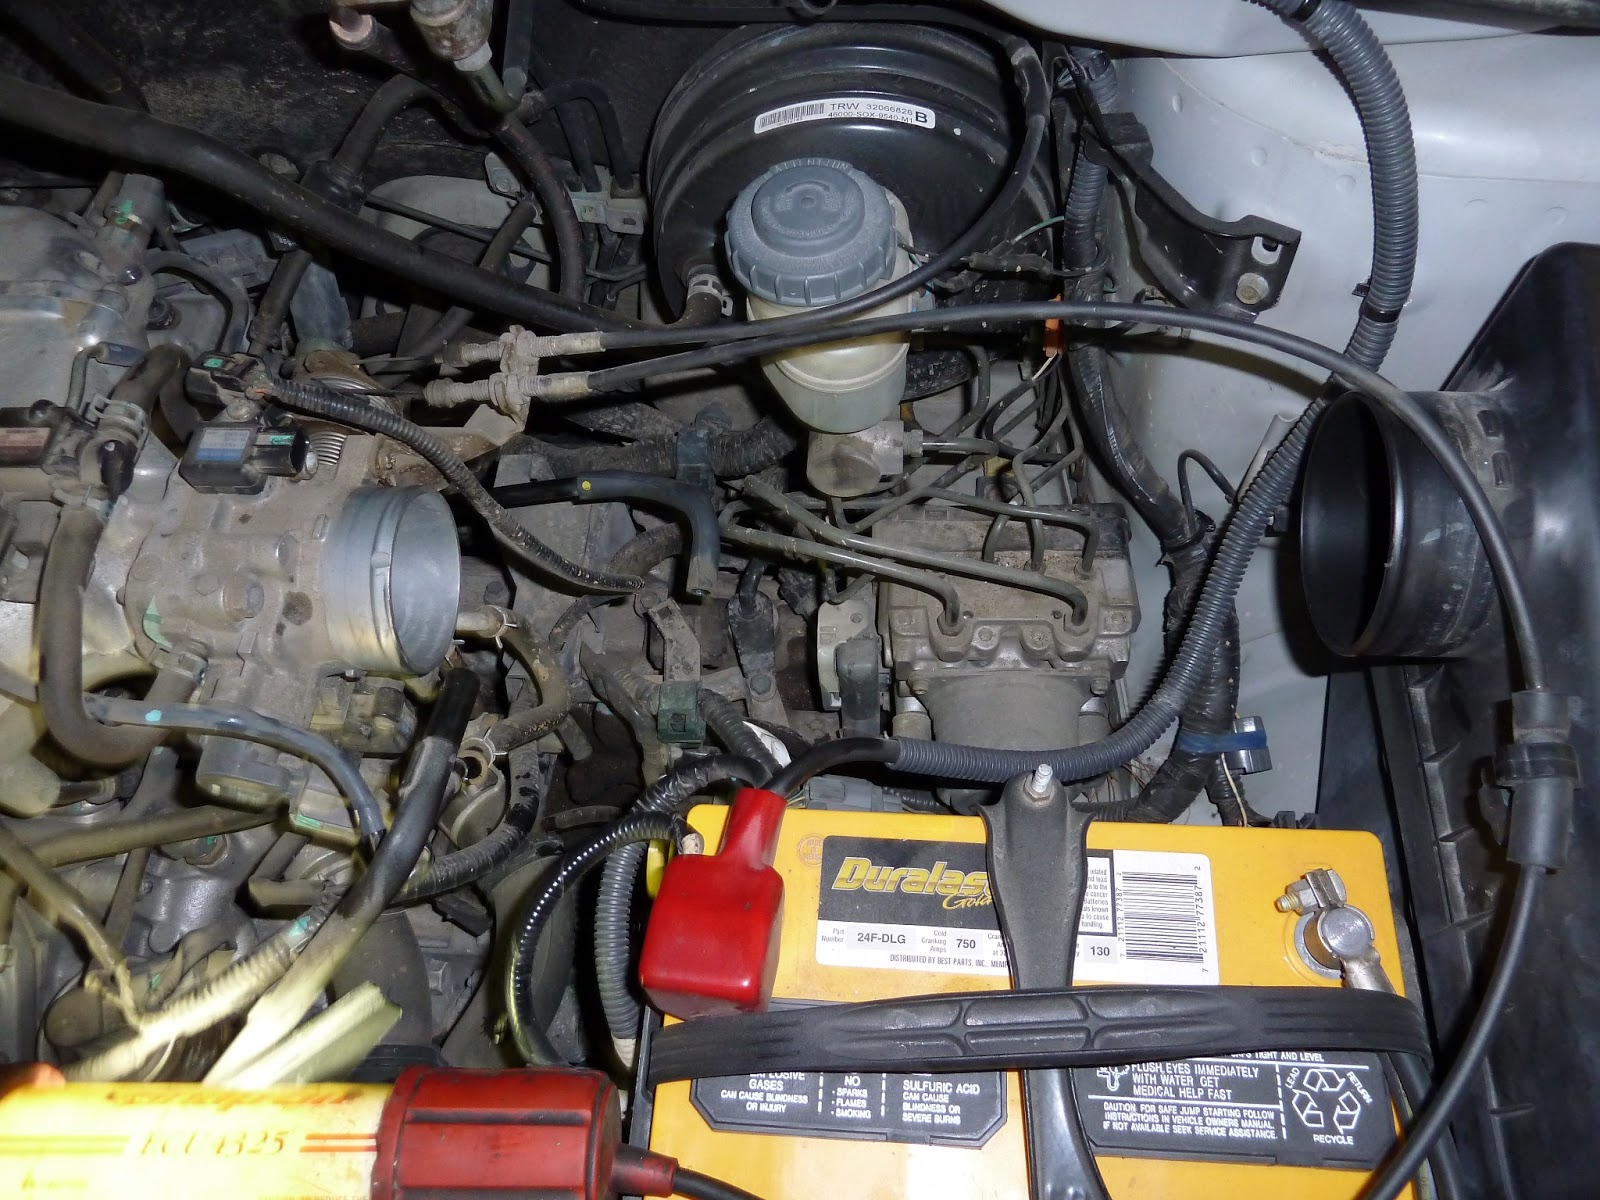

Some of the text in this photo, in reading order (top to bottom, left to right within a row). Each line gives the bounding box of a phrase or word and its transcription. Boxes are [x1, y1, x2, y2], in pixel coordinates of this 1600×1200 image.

[915, 111, 928, 123] B
[832, 856, 991, 896] Duralas
[1116, 887, 1124, 912] 77387
[1194, 885, 1204, 916] 77387
[822, 935, 844, 943] Number
[857, 932, 906, 944] 24F-DLG
[921, 937, 947, 946] Cranking
[956, 938, 976, 949] 750
[1197, 921, 1207, 954] 21112
[930, 945, 947, 953] Amps
[1090, 946, 1110, 956] 130
[890, 954, 927, 963] DISTRIBUTED
[928, 956, 936, 964] BY
[937, 956, 951, 965] BEST
[1280, 1051, 1298, 1061] AND
[1300, 1052, 1324, 1062] LEVEL
[1165, 1062, 1191, 1075] EYES
[1194, 1064, 1259, 1078] IMMEDIATELY
[844, 1075, 861, 1086] NO
[1132, 1072, 1219, 1087] WITH WATER GET
[1285, 1067, 1300, 1089] LEAD
[748, 1078, 783, 1092] GASES
[903, 1079, 980, 1095] SULFURIC ACID
[1346, 1071, 1373, 1105] RETURN
[720, 1090, 809, 1104] CAN CAUSE BLINDNESS
[836, 1087, 868, 1098] SPARKS
[902, 1093, 949, 1103] CAN CAUSE
[1133, 1084, 1232, 1100] MEDICAL HELP FAST
[746, 1102, 787, 1113] OR INJURY
[835, 1097, 867, 1108] FLAMES
[902, 1102, 961, 1114] BLINDNESS OR
[835, 1109, 872, 1119] SMOKING
[1140, 1104, 1157, 1113] FOR
[1158, 1105, 1178, 1114] SAFE
[1180, 1105, 1200, 1115] JUMP
[1203, 1106, 1241, 1118] STARTING
[1243, 1109, 1275, 1120] FOLLOW
[902, 1112, 961, 1125] SEVERE BURNS
[1104, 1112, 1159, 1123] INSTRUCTIONS
[1161, 1115, 1170, 1124] IN
[1172, 1116, 1203, 1126] VEHICLE
[1205, 1117, 1239, 1128] OWNERS
[1102, 1121, 1110, 1130] IF
[1112, 1121, 1128, 1131] NOT
[1130, 1122, 1170, 1133] AVAILABLE
[1172, 1124, 1192, 1134] SEEK
[1194, 1126, 1226, 1137] SERVICE
[1313, 1134, 1354, 1145] RECYCLE
